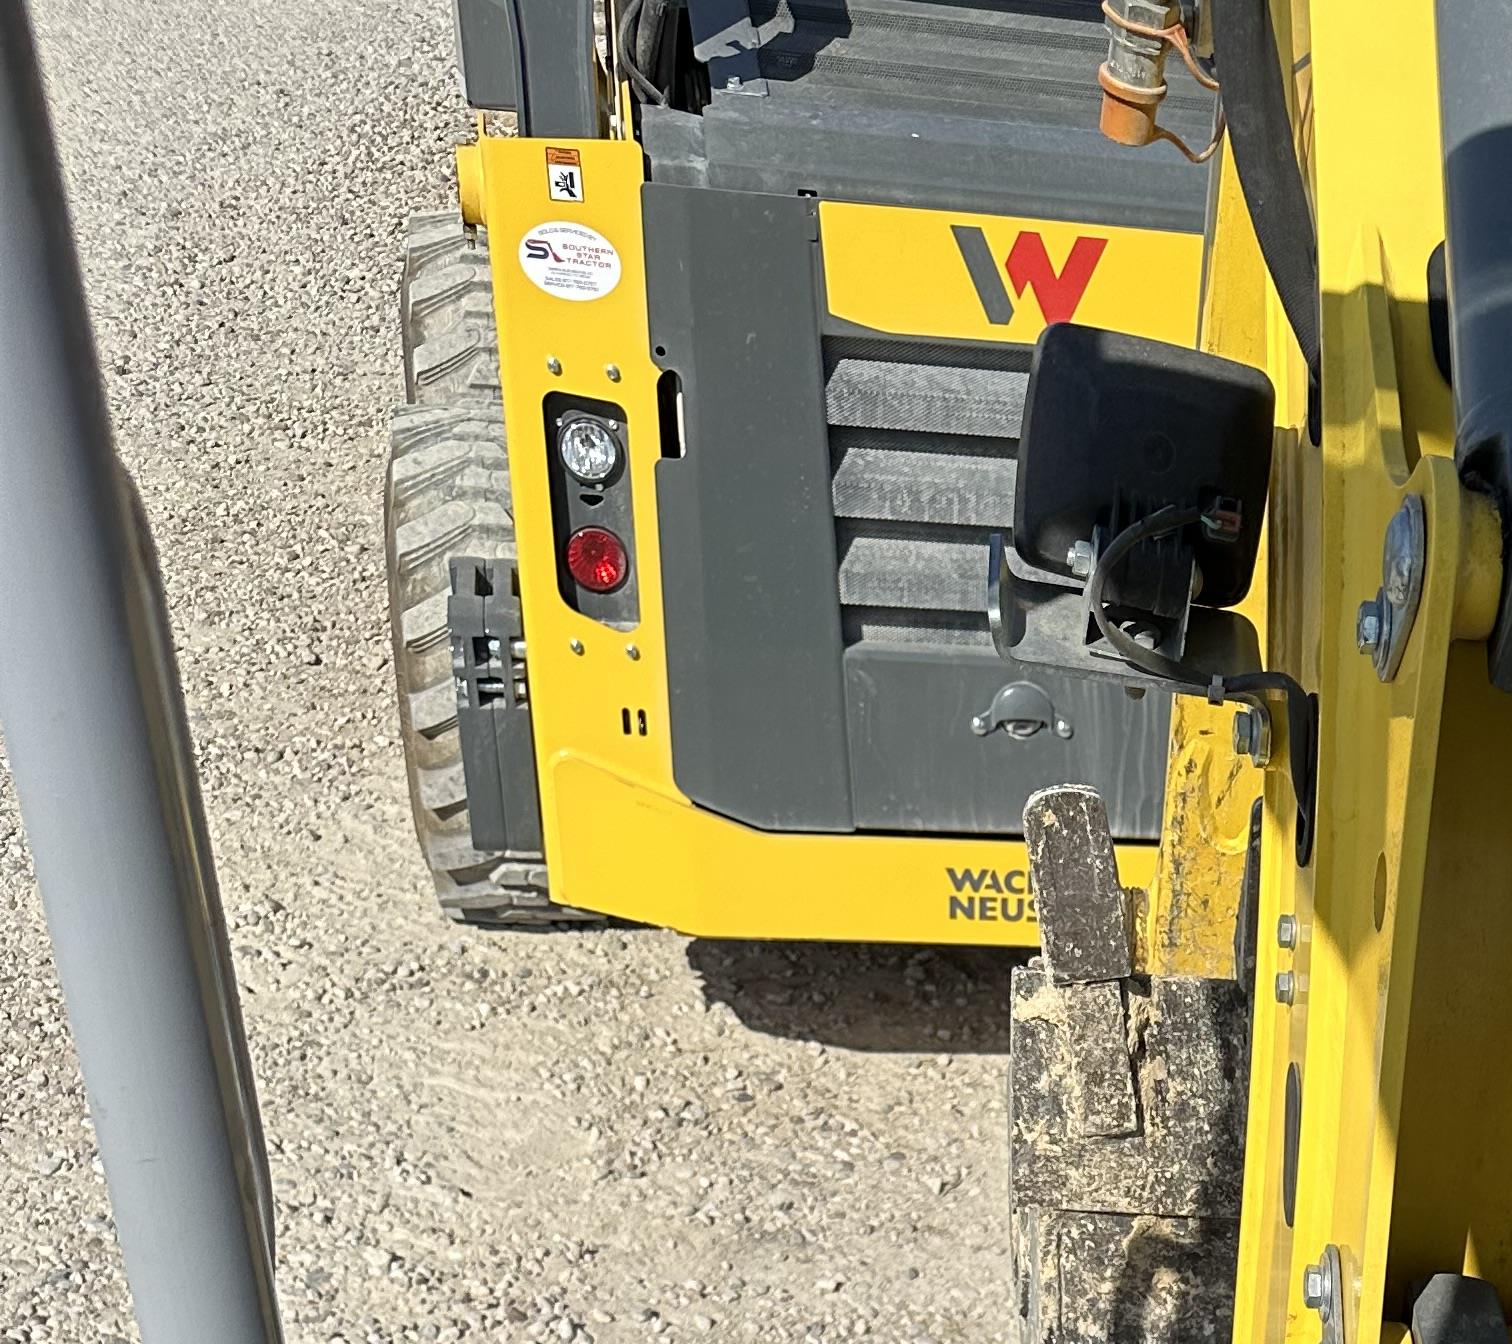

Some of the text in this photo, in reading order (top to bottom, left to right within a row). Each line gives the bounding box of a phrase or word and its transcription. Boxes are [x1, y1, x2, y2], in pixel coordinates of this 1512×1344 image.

[562, 243, 614, 255] SOUTHERN
[576, 252, 601, 260] STAR
[566, 257, 612, 270] TRACTOR
